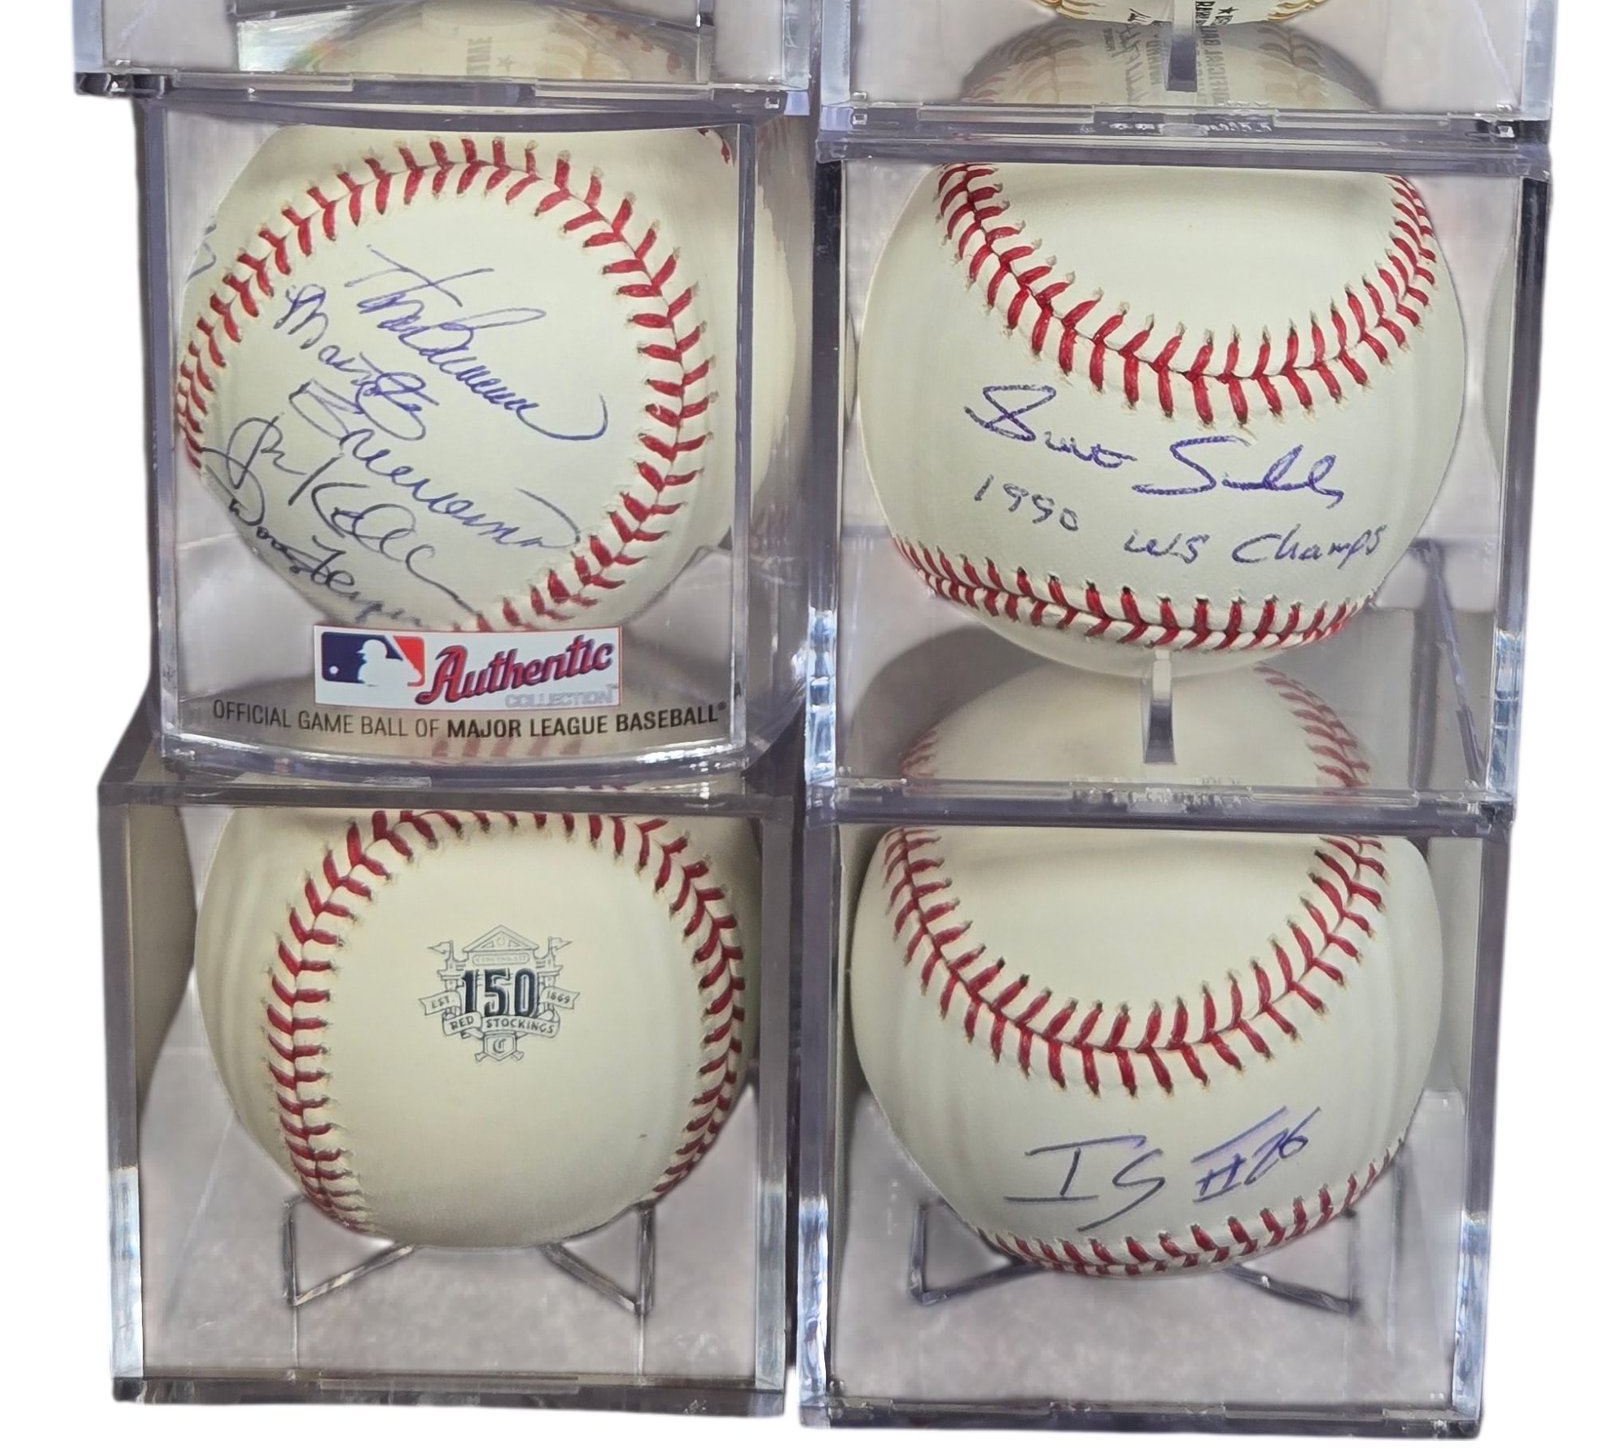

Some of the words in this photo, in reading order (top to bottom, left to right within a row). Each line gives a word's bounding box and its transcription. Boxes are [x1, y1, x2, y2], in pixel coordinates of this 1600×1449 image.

[972, 474, 1080, 532] 1990
[414, 634, 616, 705] Authentic
[212, 698, 292, 729] OFFICIAL
[297, 709, 354, 734] GAME
[361, 715, 409, 738] BALL
[415, 717, 440, 738] OF
[447, 718, 522, 739] MAJOR
[529, 714, 609, 738] LEAGUE
[462, 967, 540, 1018] 150
[450, 1015, 475, 1031] RED
[486, 1017, 555, 1035] STOCKINGS
